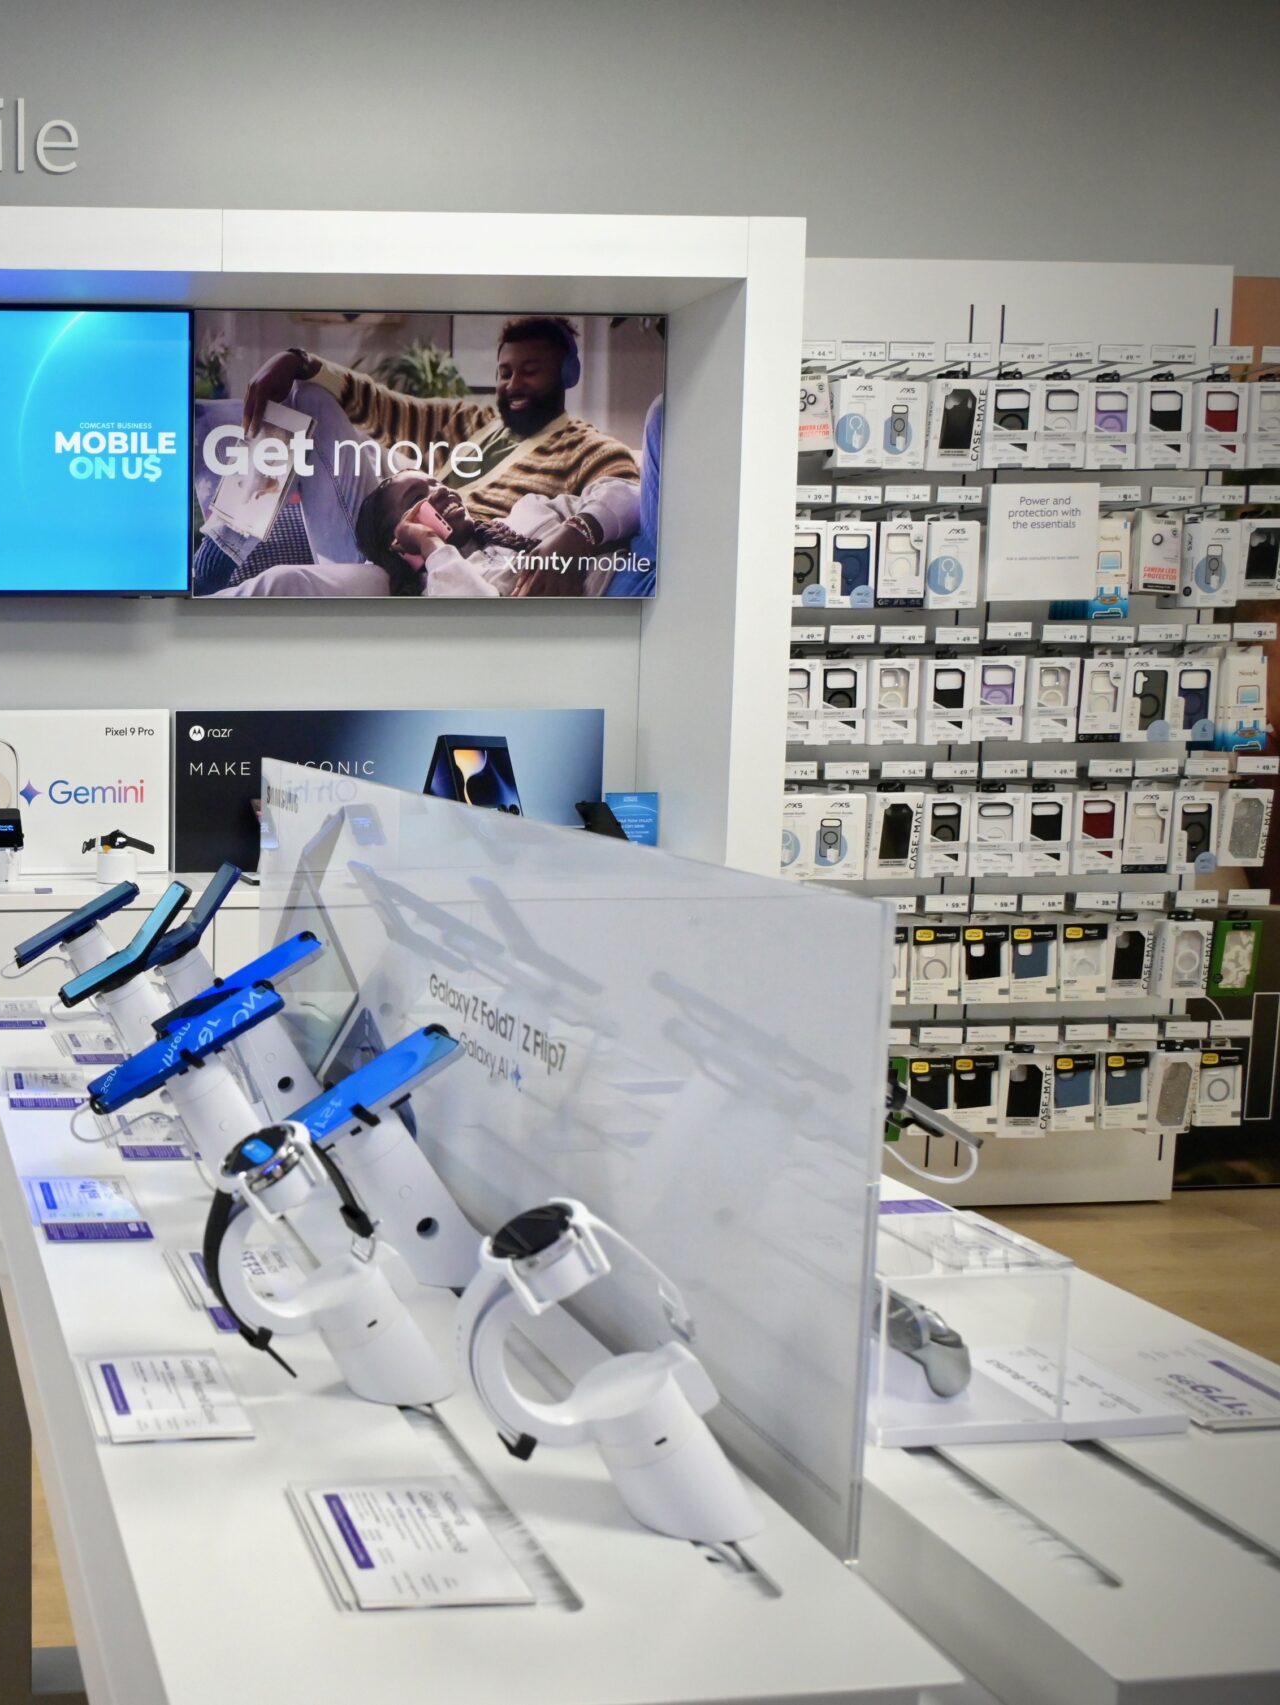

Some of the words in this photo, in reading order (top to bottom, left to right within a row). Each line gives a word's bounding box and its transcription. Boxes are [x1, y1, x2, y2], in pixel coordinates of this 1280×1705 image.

[54, 431, 176, 454] MOBILE
[203, 424, 314, 478] Get
[333, 438, 484, 478] more
[69, 456, 116, 480] ON
[1019, 496, 1050, 506] Power
[1052, 496, 1072, 506] and
[1008, 508, 1059, 519] protection
[1061, 507, 1081, 517] with
[1012, 520, 1028, 529] the
[1030, 519, 1076, 529] essentials
[502, 550, 574, 574] xfinity
[578, 551, 651, 573] mobile
[104, 727, 128, 737] Pixel
[129, 727, 136, 737] 9
[138, 727, 155, 737] Pro
[207, 728, 233, 738] razr
[189, 762, 251, 776] MAKE
[296, 761, 375, 775] ONIC
[48, 779, 145, 805] Gemini
[429, 973, 470, 1023] Galaxy
[471, 996, 479, 1022] Z
[480, 1001, 515, 1042] Fold7
[522, 1023, 531, 1053] Z
[533, 1029, 567, 1076] Flip7
[458, 1031, 497, 1079] Galaxy
